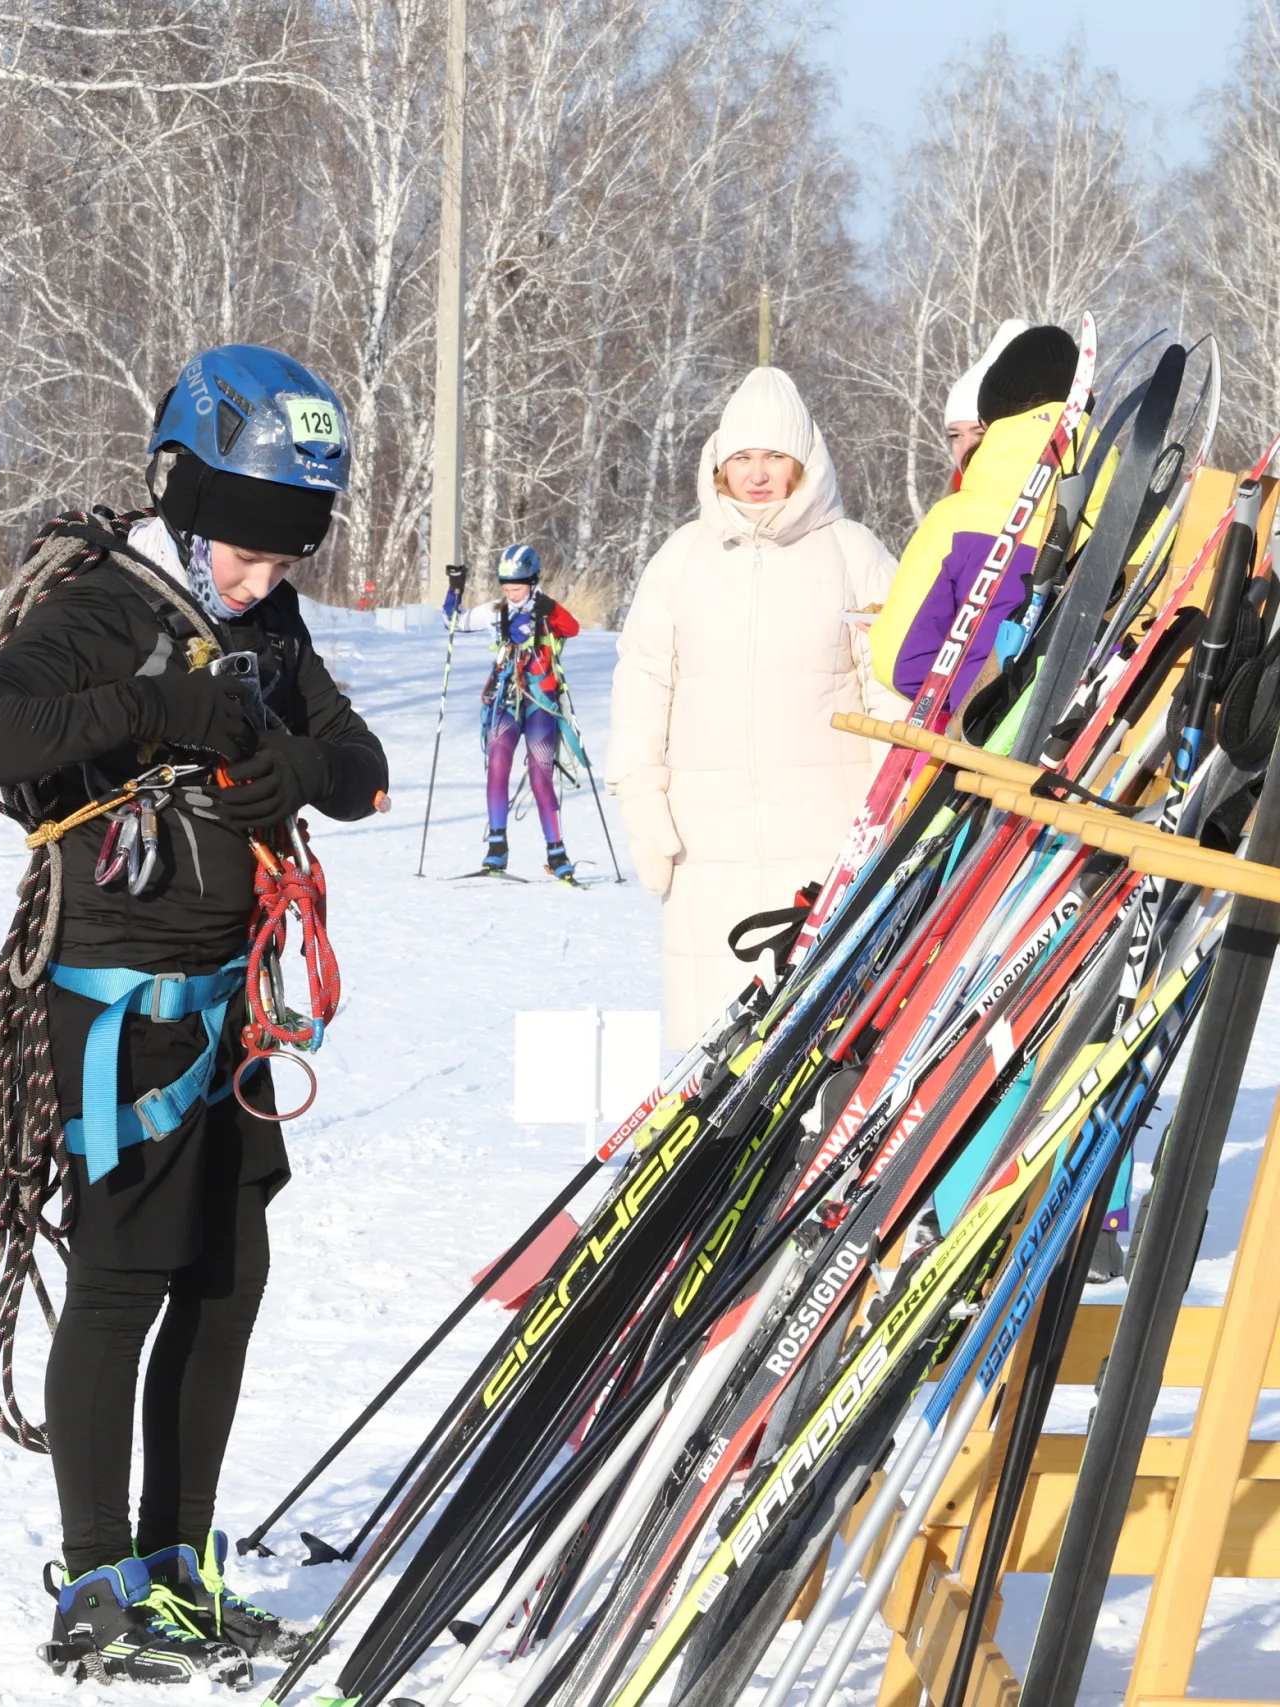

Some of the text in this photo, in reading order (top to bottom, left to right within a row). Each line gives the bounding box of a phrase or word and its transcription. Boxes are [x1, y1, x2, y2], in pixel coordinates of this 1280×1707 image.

[186, 354, 215, 416] VENTO
[300, 411, 332, 435] 129
[931, 463, 1053, 676] BRADOS
[913, 697, 930, 717] 175
[982, 928, 1053, 1013] NORDWAY
[1113, 1004, 1125, 1035] DIA
[606, 1108, 647, 1153] SPORT
[786, 1094, 868, 1211] RDWAY
[840, 1147, 859, 1170] XC
[858, 1116, 888, 1150] ACTIVE
[483, 1115, 700, 1409] FISCHER
[1019, 1176, 1070, 1268] CYBER
[766, 1237, 869, 1378] ROSSIGNOL
[981, 1293, 1031, 1389] CYBER
[730, 1202, 989, 1567] BRADOS PRO SKATE
[697, 1436, 731, 1484] DELTA
